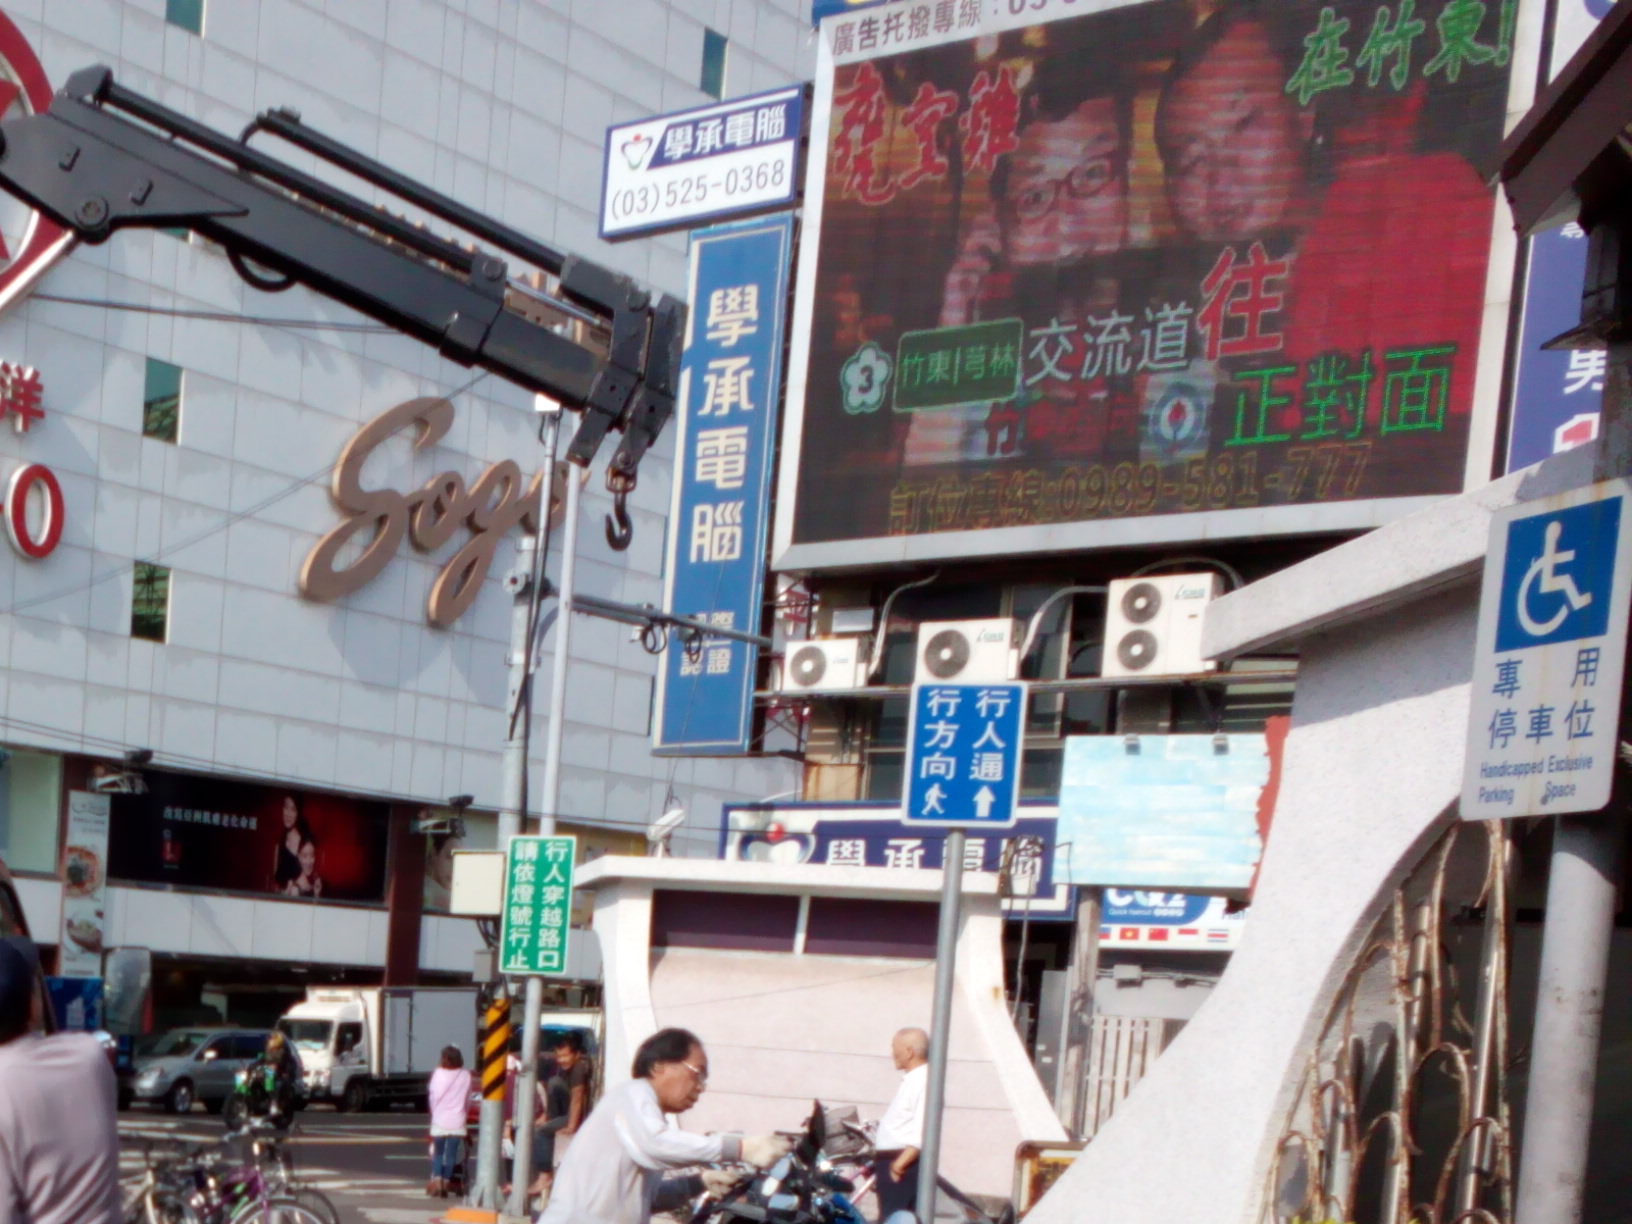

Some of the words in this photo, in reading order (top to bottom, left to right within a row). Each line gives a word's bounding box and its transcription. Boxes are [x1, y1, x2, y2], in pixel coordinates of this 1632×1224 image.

[663, 103, 787, 161] 學承電腦
[611, 158, 786, 221] (03)525-0368
[1024, 302, 1194, 387] 交流道
[1198, 243, 1290, 361] 往
[690, 284, 759, 564] 學承電腦
[1224, 344, 1456, 447] 正對面
[920, 688, 963, 781] 行方向
[969, 689, 1012, 782] 行人通
[1480, 758, 1544, 780] Handicapped
[1547, 755, 1594, 774] Exclusive
[1488, 699, 1596, 750] 停車位
[1478, 786, 1515, 806] Parking
[1544, 780, 1577, 800] Space
[505, 840, 540, 970] 請依燈號行止
[536, 840, 569, 970] 行人穿越路口
